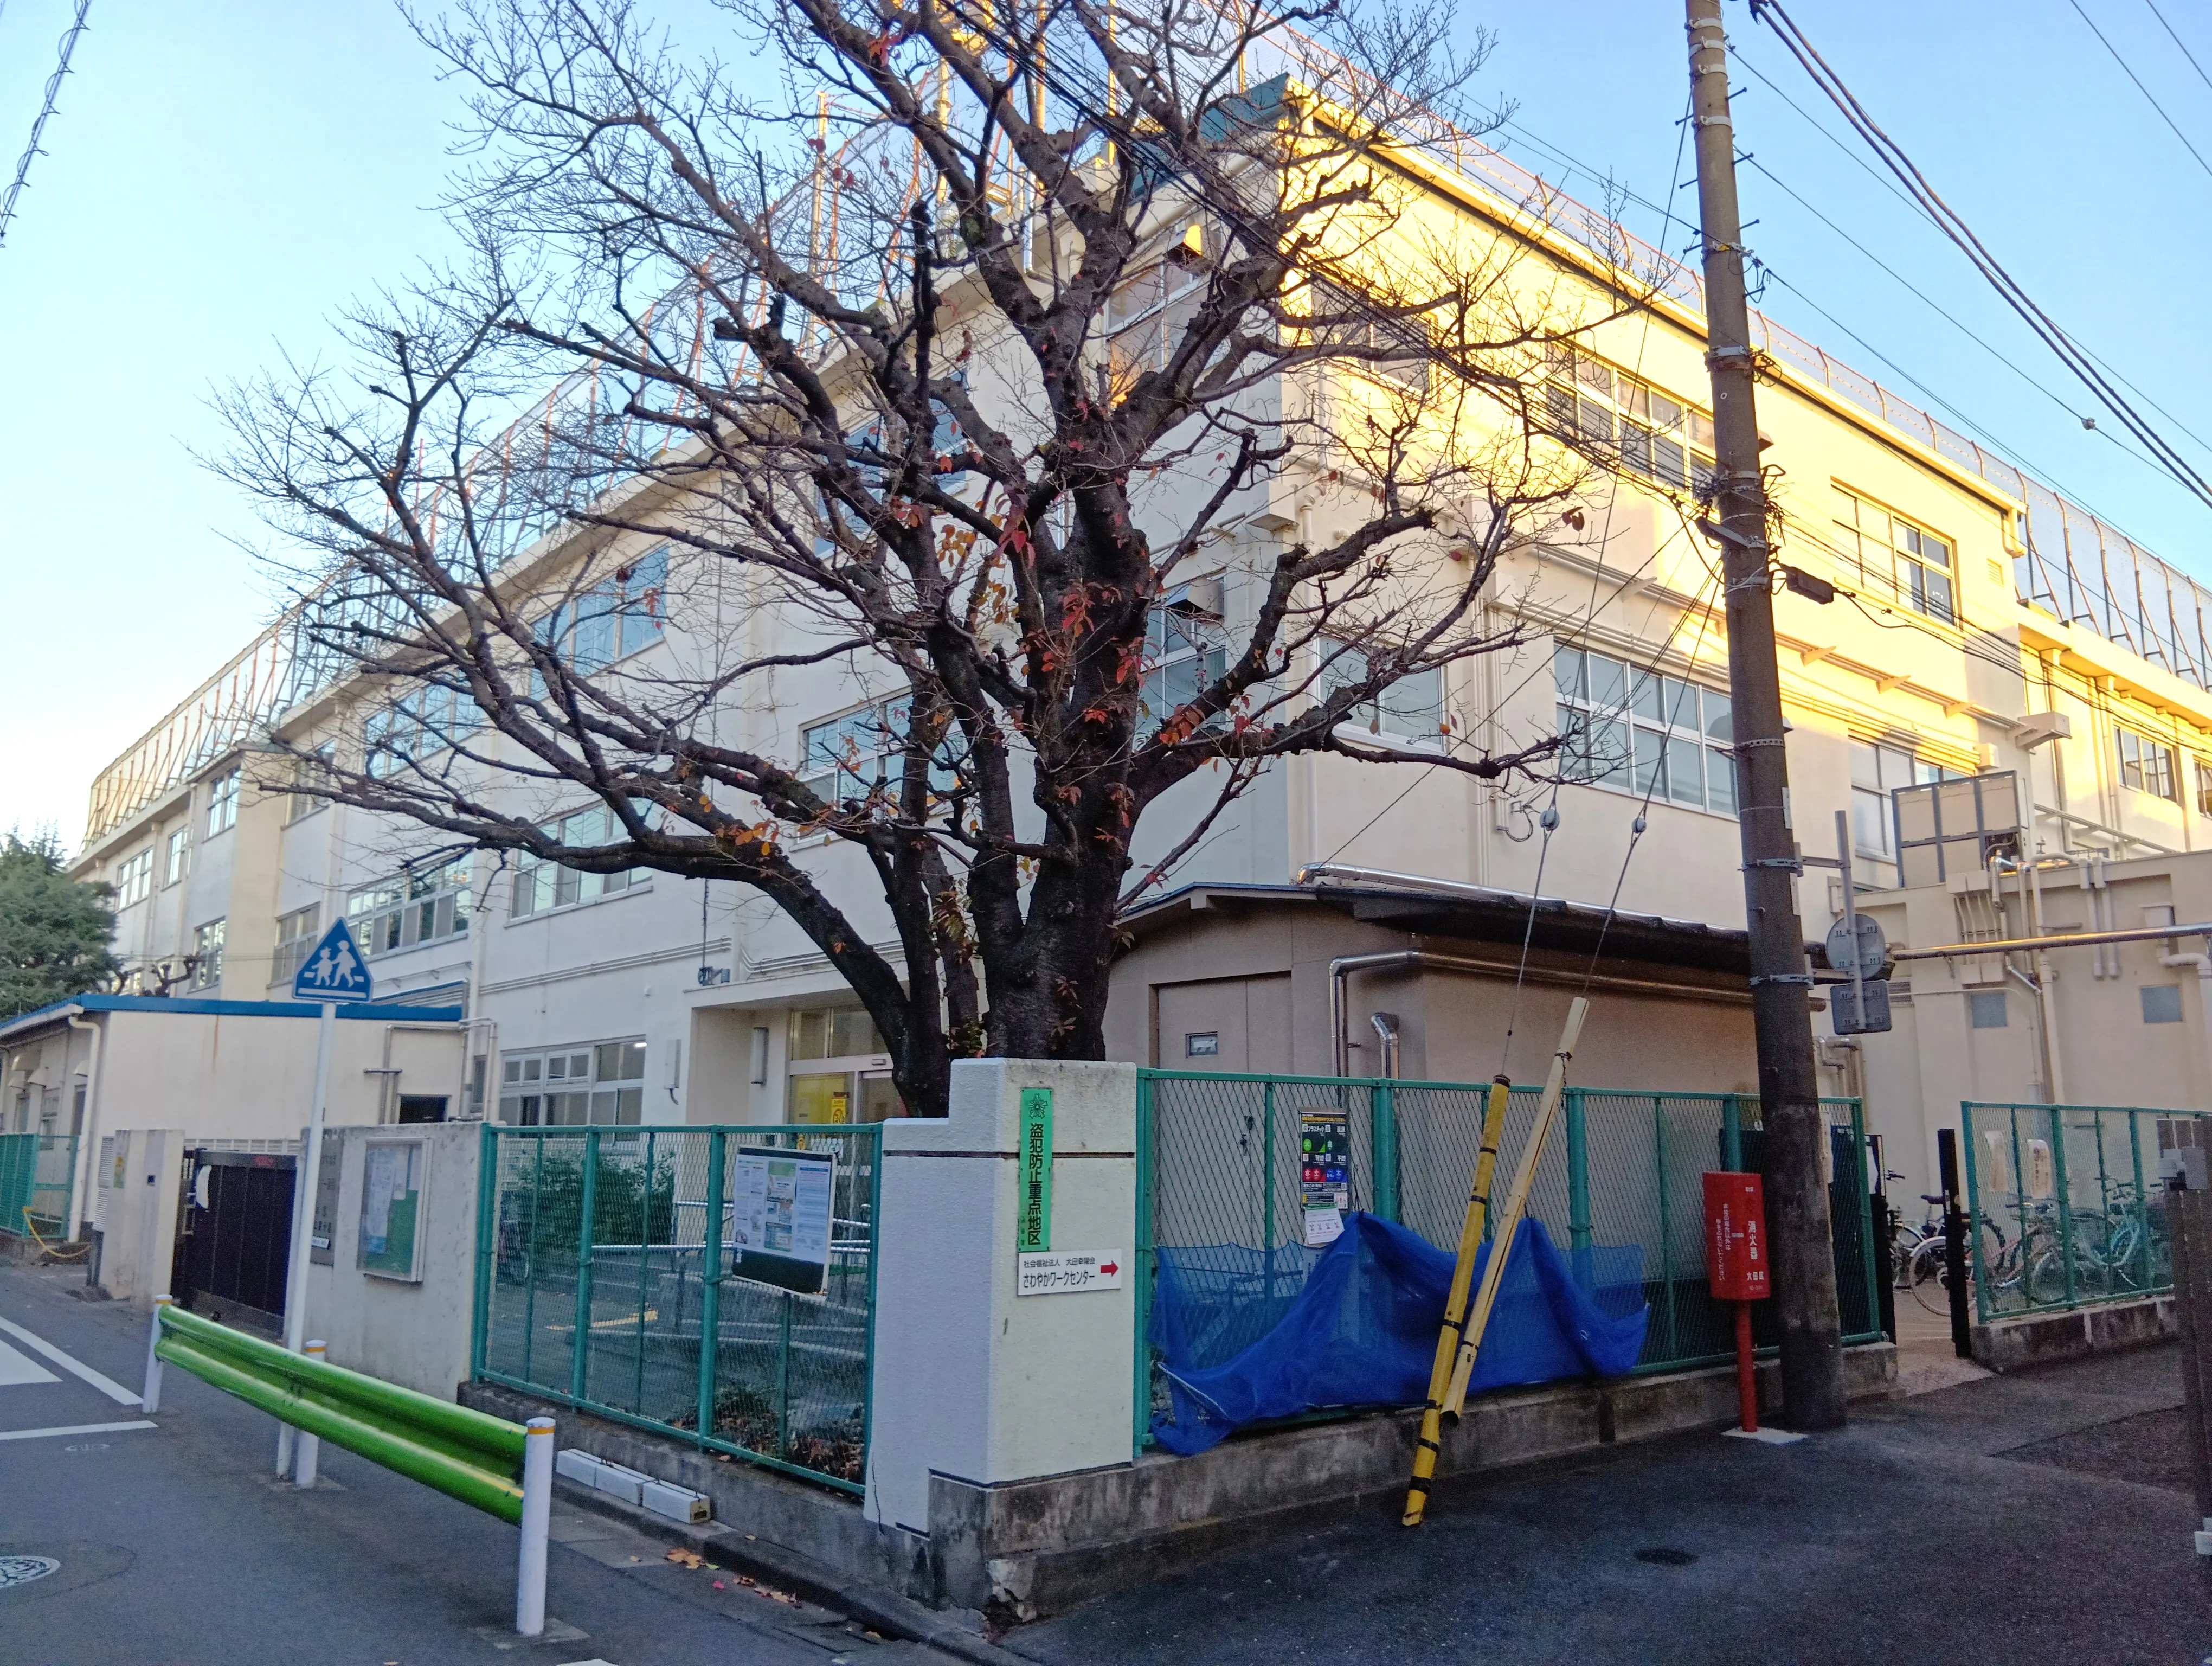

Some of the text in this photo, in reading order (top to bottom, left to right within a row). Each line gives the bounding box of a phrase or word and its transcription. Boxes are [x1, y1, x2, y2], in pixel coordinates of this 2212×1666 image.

[1027, 1123, 1044, 1246] 盗犯防止重点地区
[1024, 1259, 1060, 1268] 社会福祉法人
[1023, 1270, 1095, 1289] さわやかワークセンター
